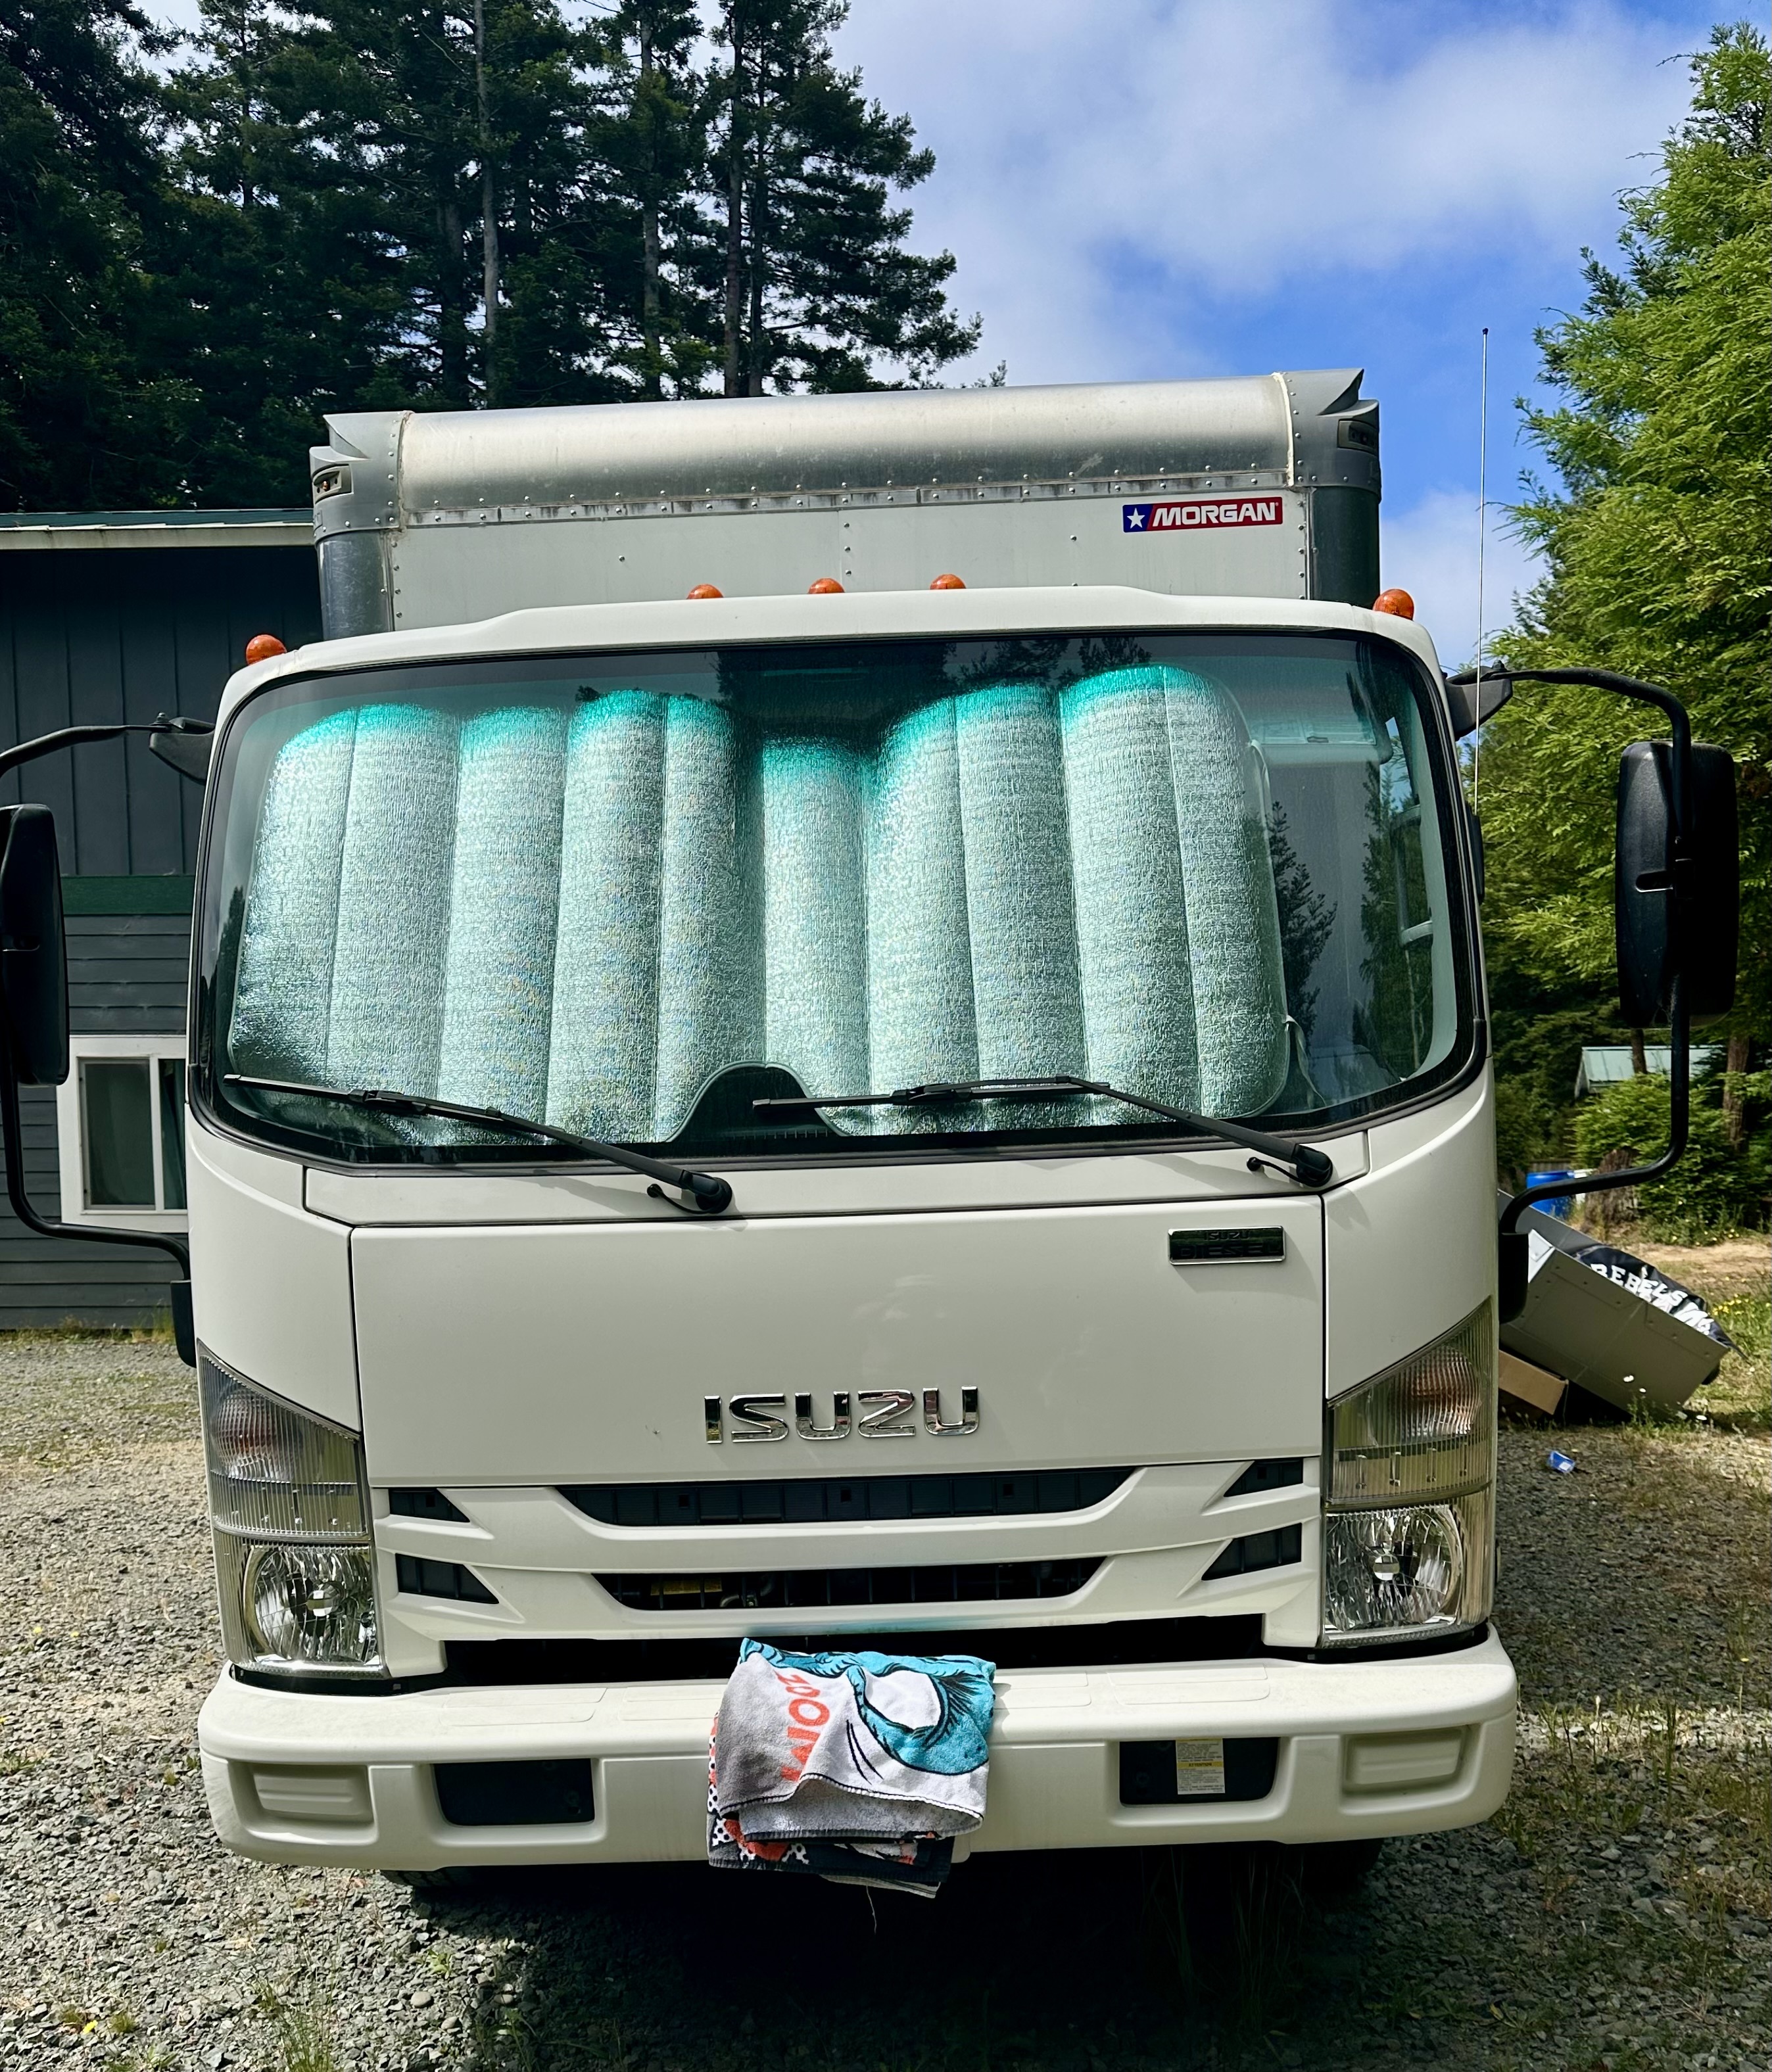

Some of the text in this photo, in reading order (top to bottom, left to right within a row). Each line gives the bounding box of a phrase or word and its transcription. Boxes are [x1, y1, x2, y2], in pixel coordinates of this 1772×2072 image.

[1152, 502, 1276, 527] MORGAN
[1206, 1230, 1251, 1242] ISUZU
[1177, 1242, 1281, 1260] DIESEL
[704, 1386, 979, 1444] ISUZU
